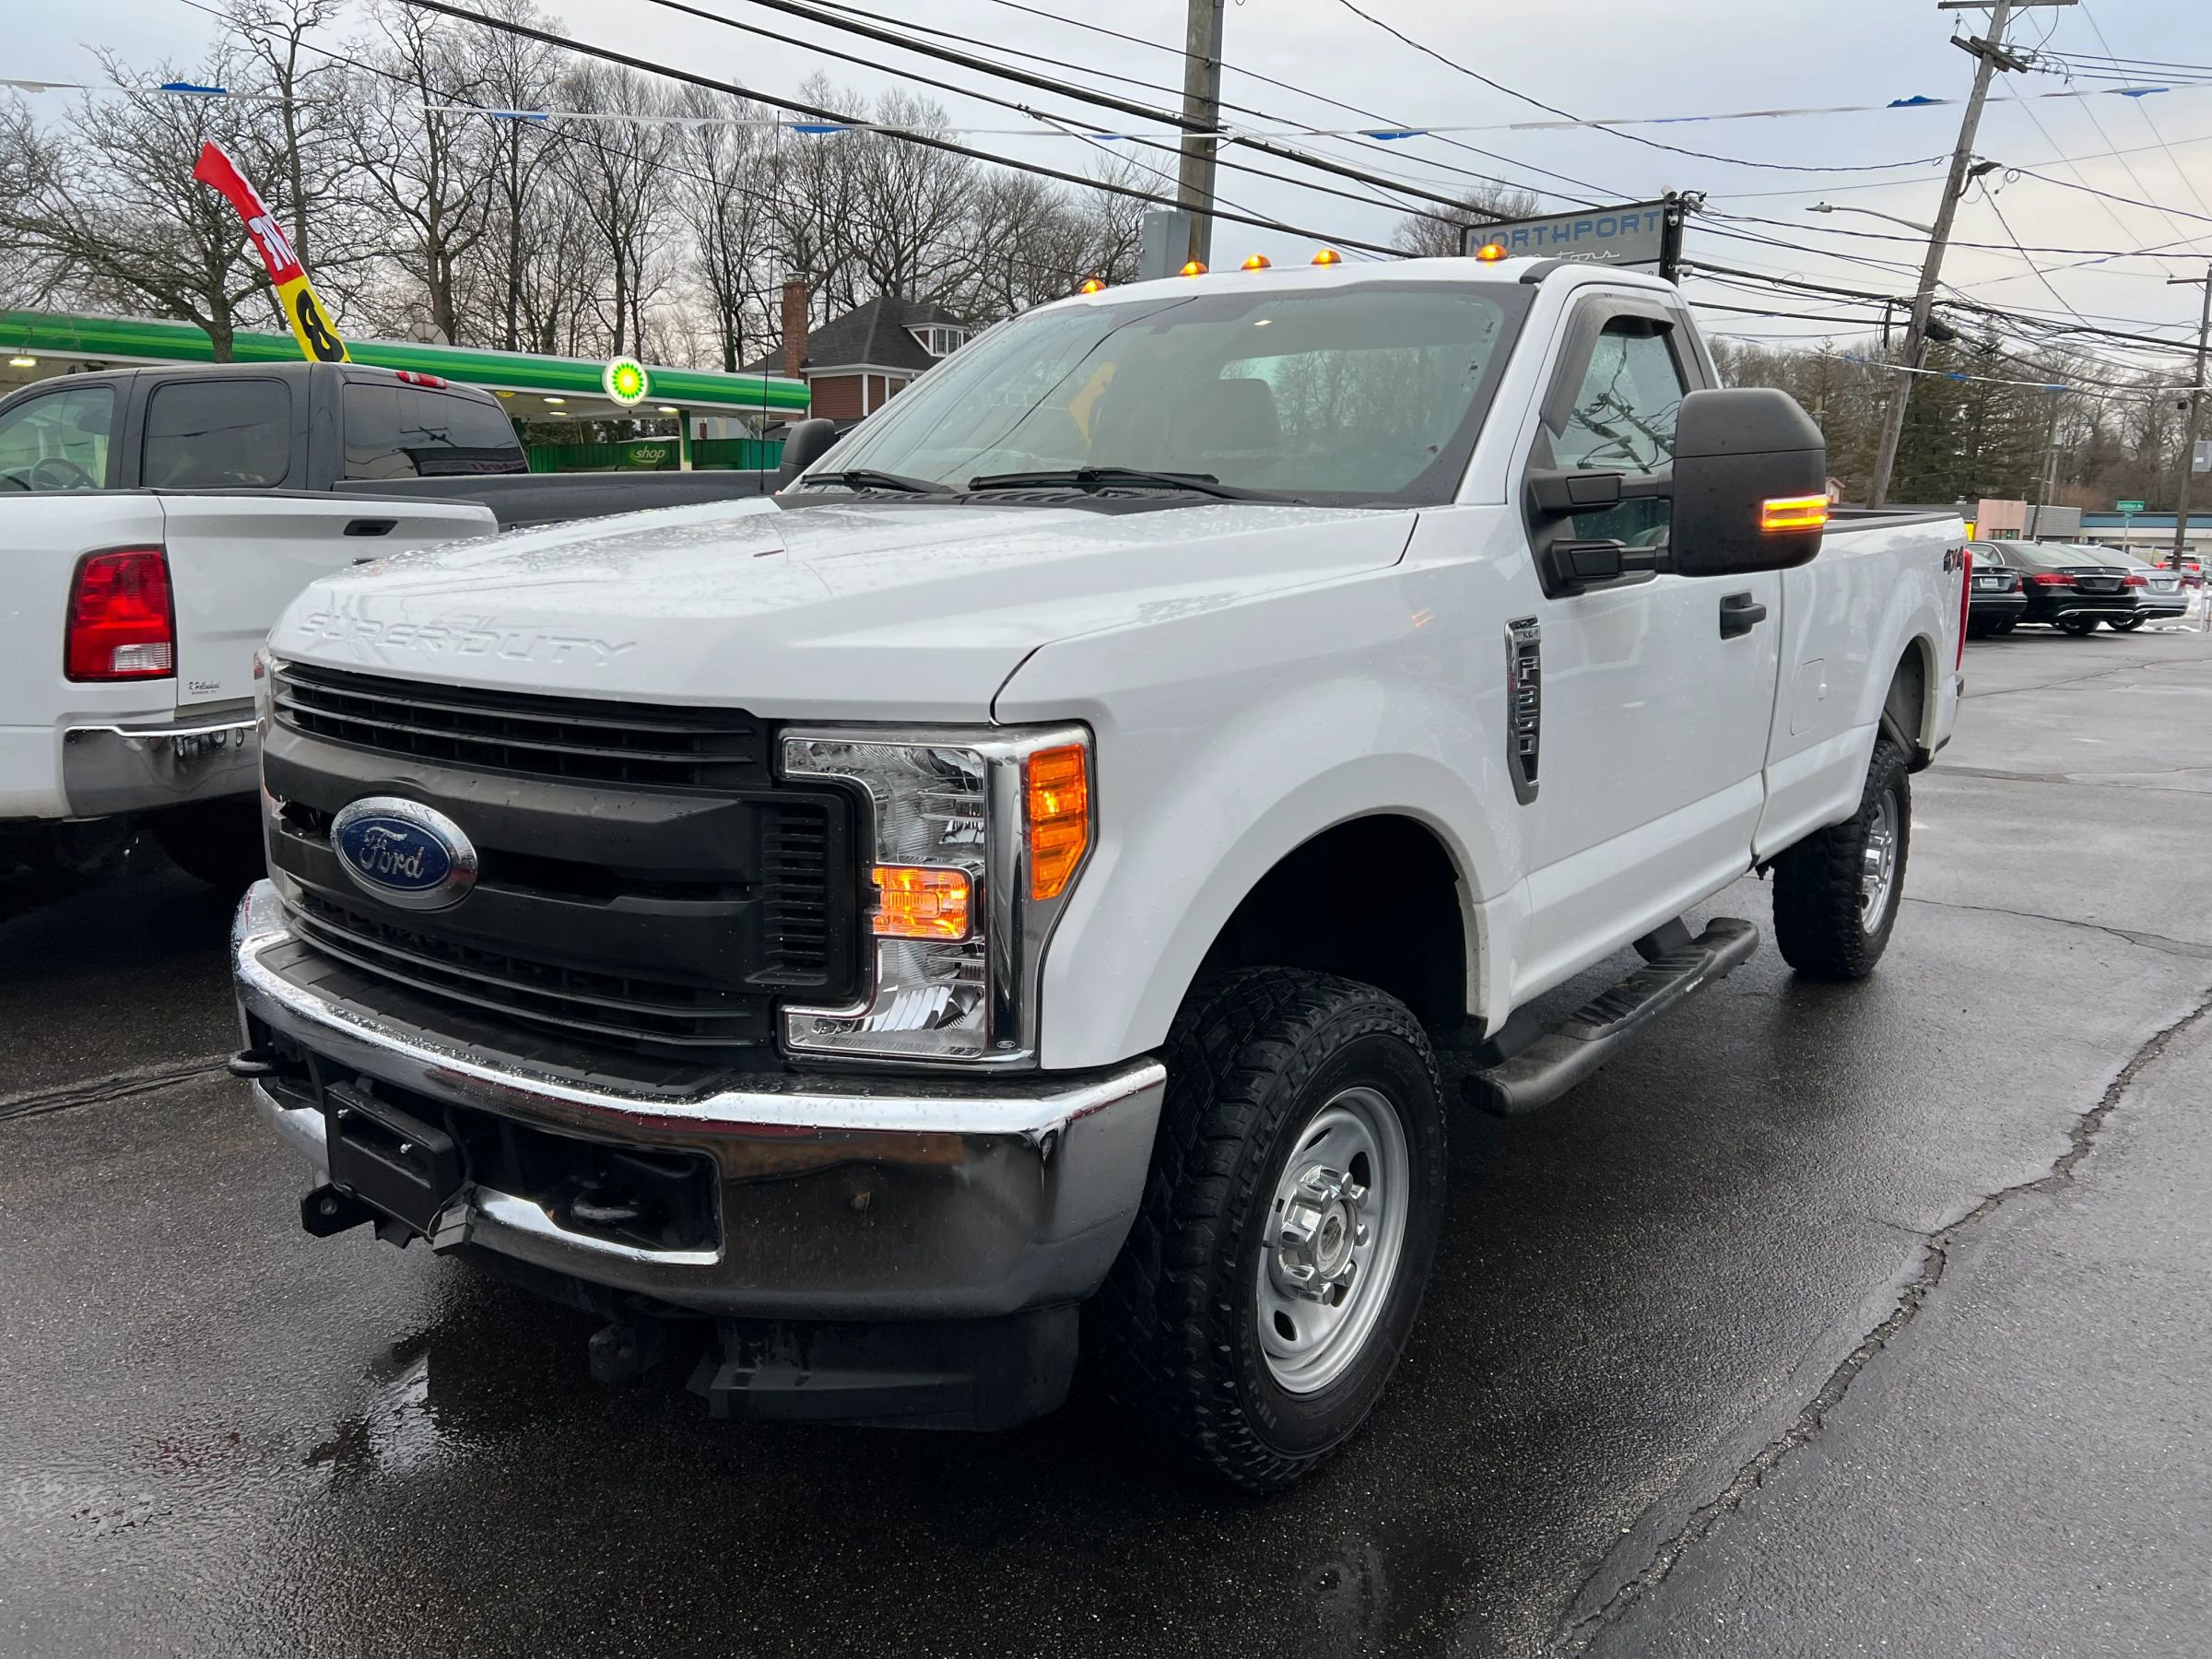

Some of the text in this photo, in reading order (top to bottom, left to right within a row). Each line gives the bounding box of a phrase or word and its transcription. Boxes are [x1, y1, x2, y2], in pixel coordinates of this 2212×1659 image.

[1470, 211, 1660, 252] NORTHPORT
[634, 445, 665, 463] shop
[458, 630, 637, 666] DUTY
[359, 826, 424, 879] Ford
